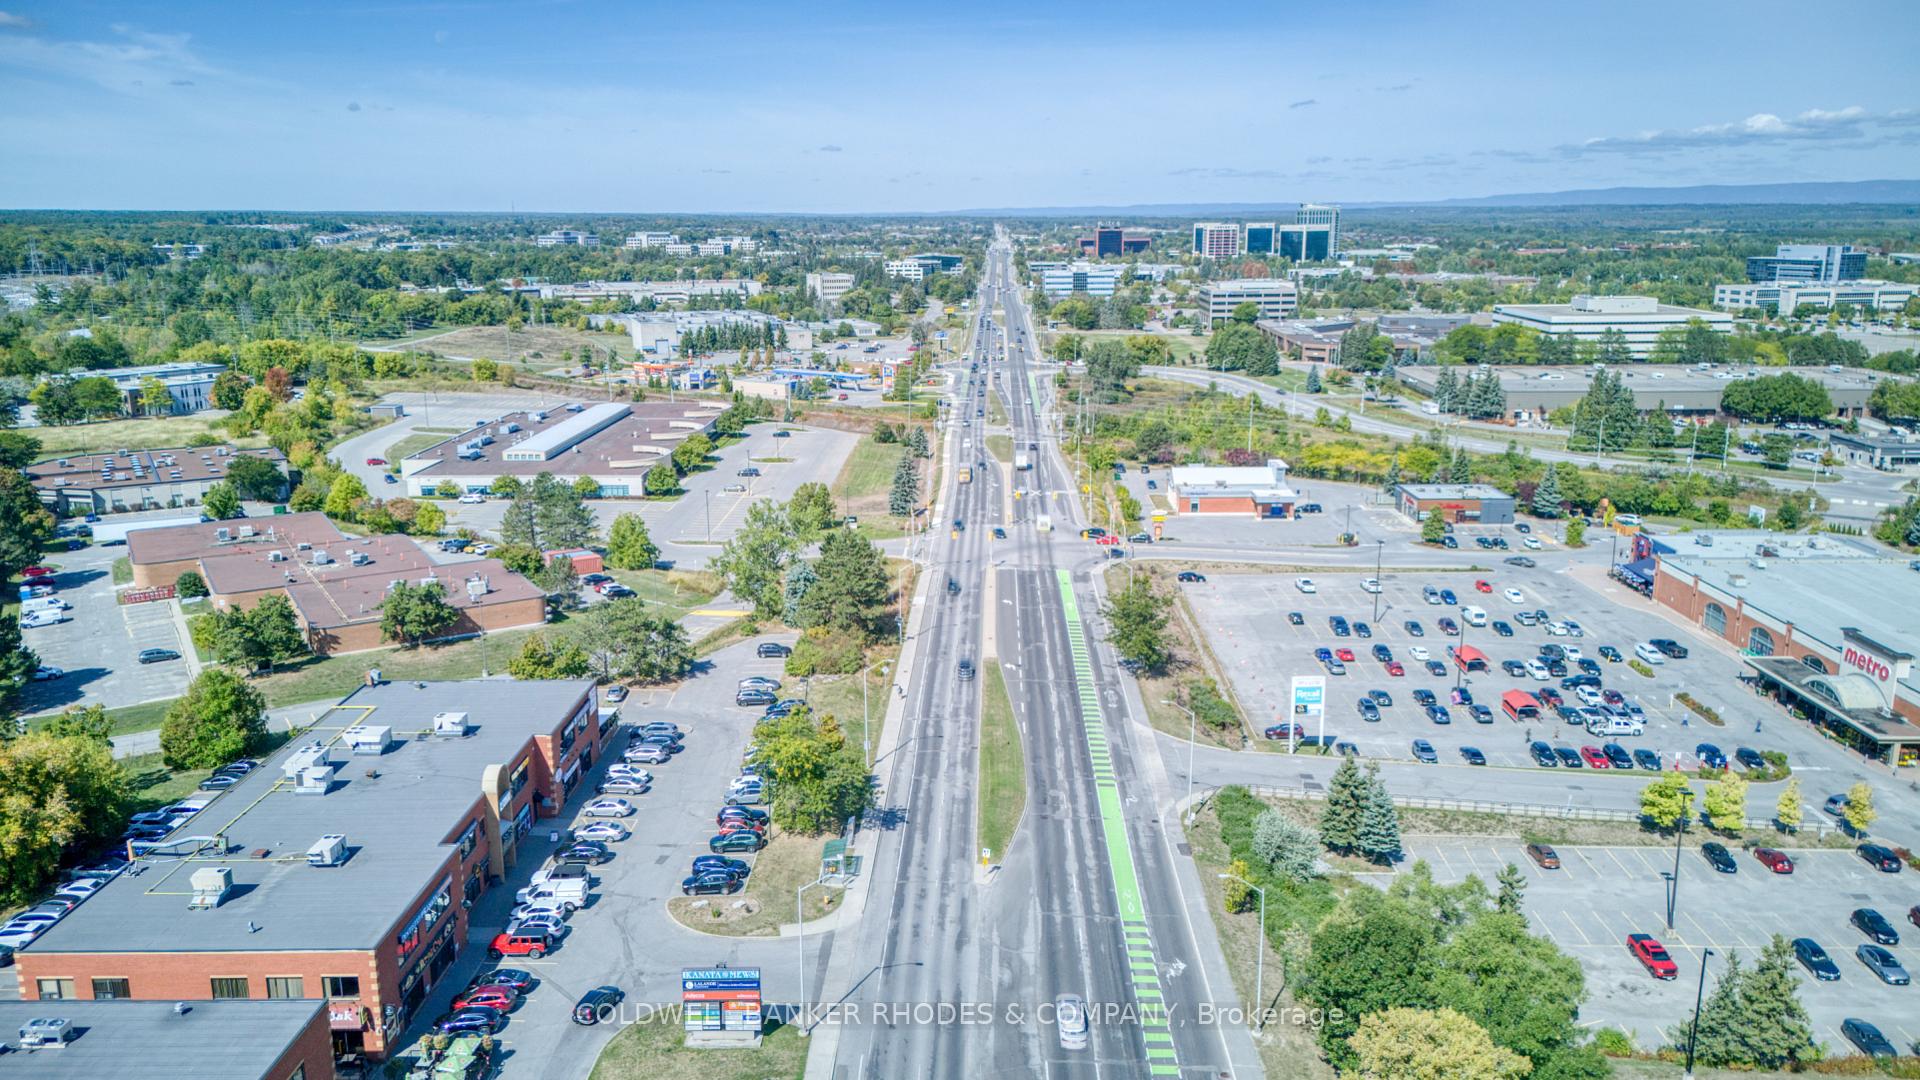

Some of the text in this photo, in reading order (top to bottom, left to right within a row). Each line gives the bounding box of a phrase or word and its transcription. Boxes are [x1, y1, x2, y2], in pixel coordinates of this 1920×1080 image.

[1844, 647, 1890, 682] metro
[686, 970, 756, 979] KANATA MEWS
